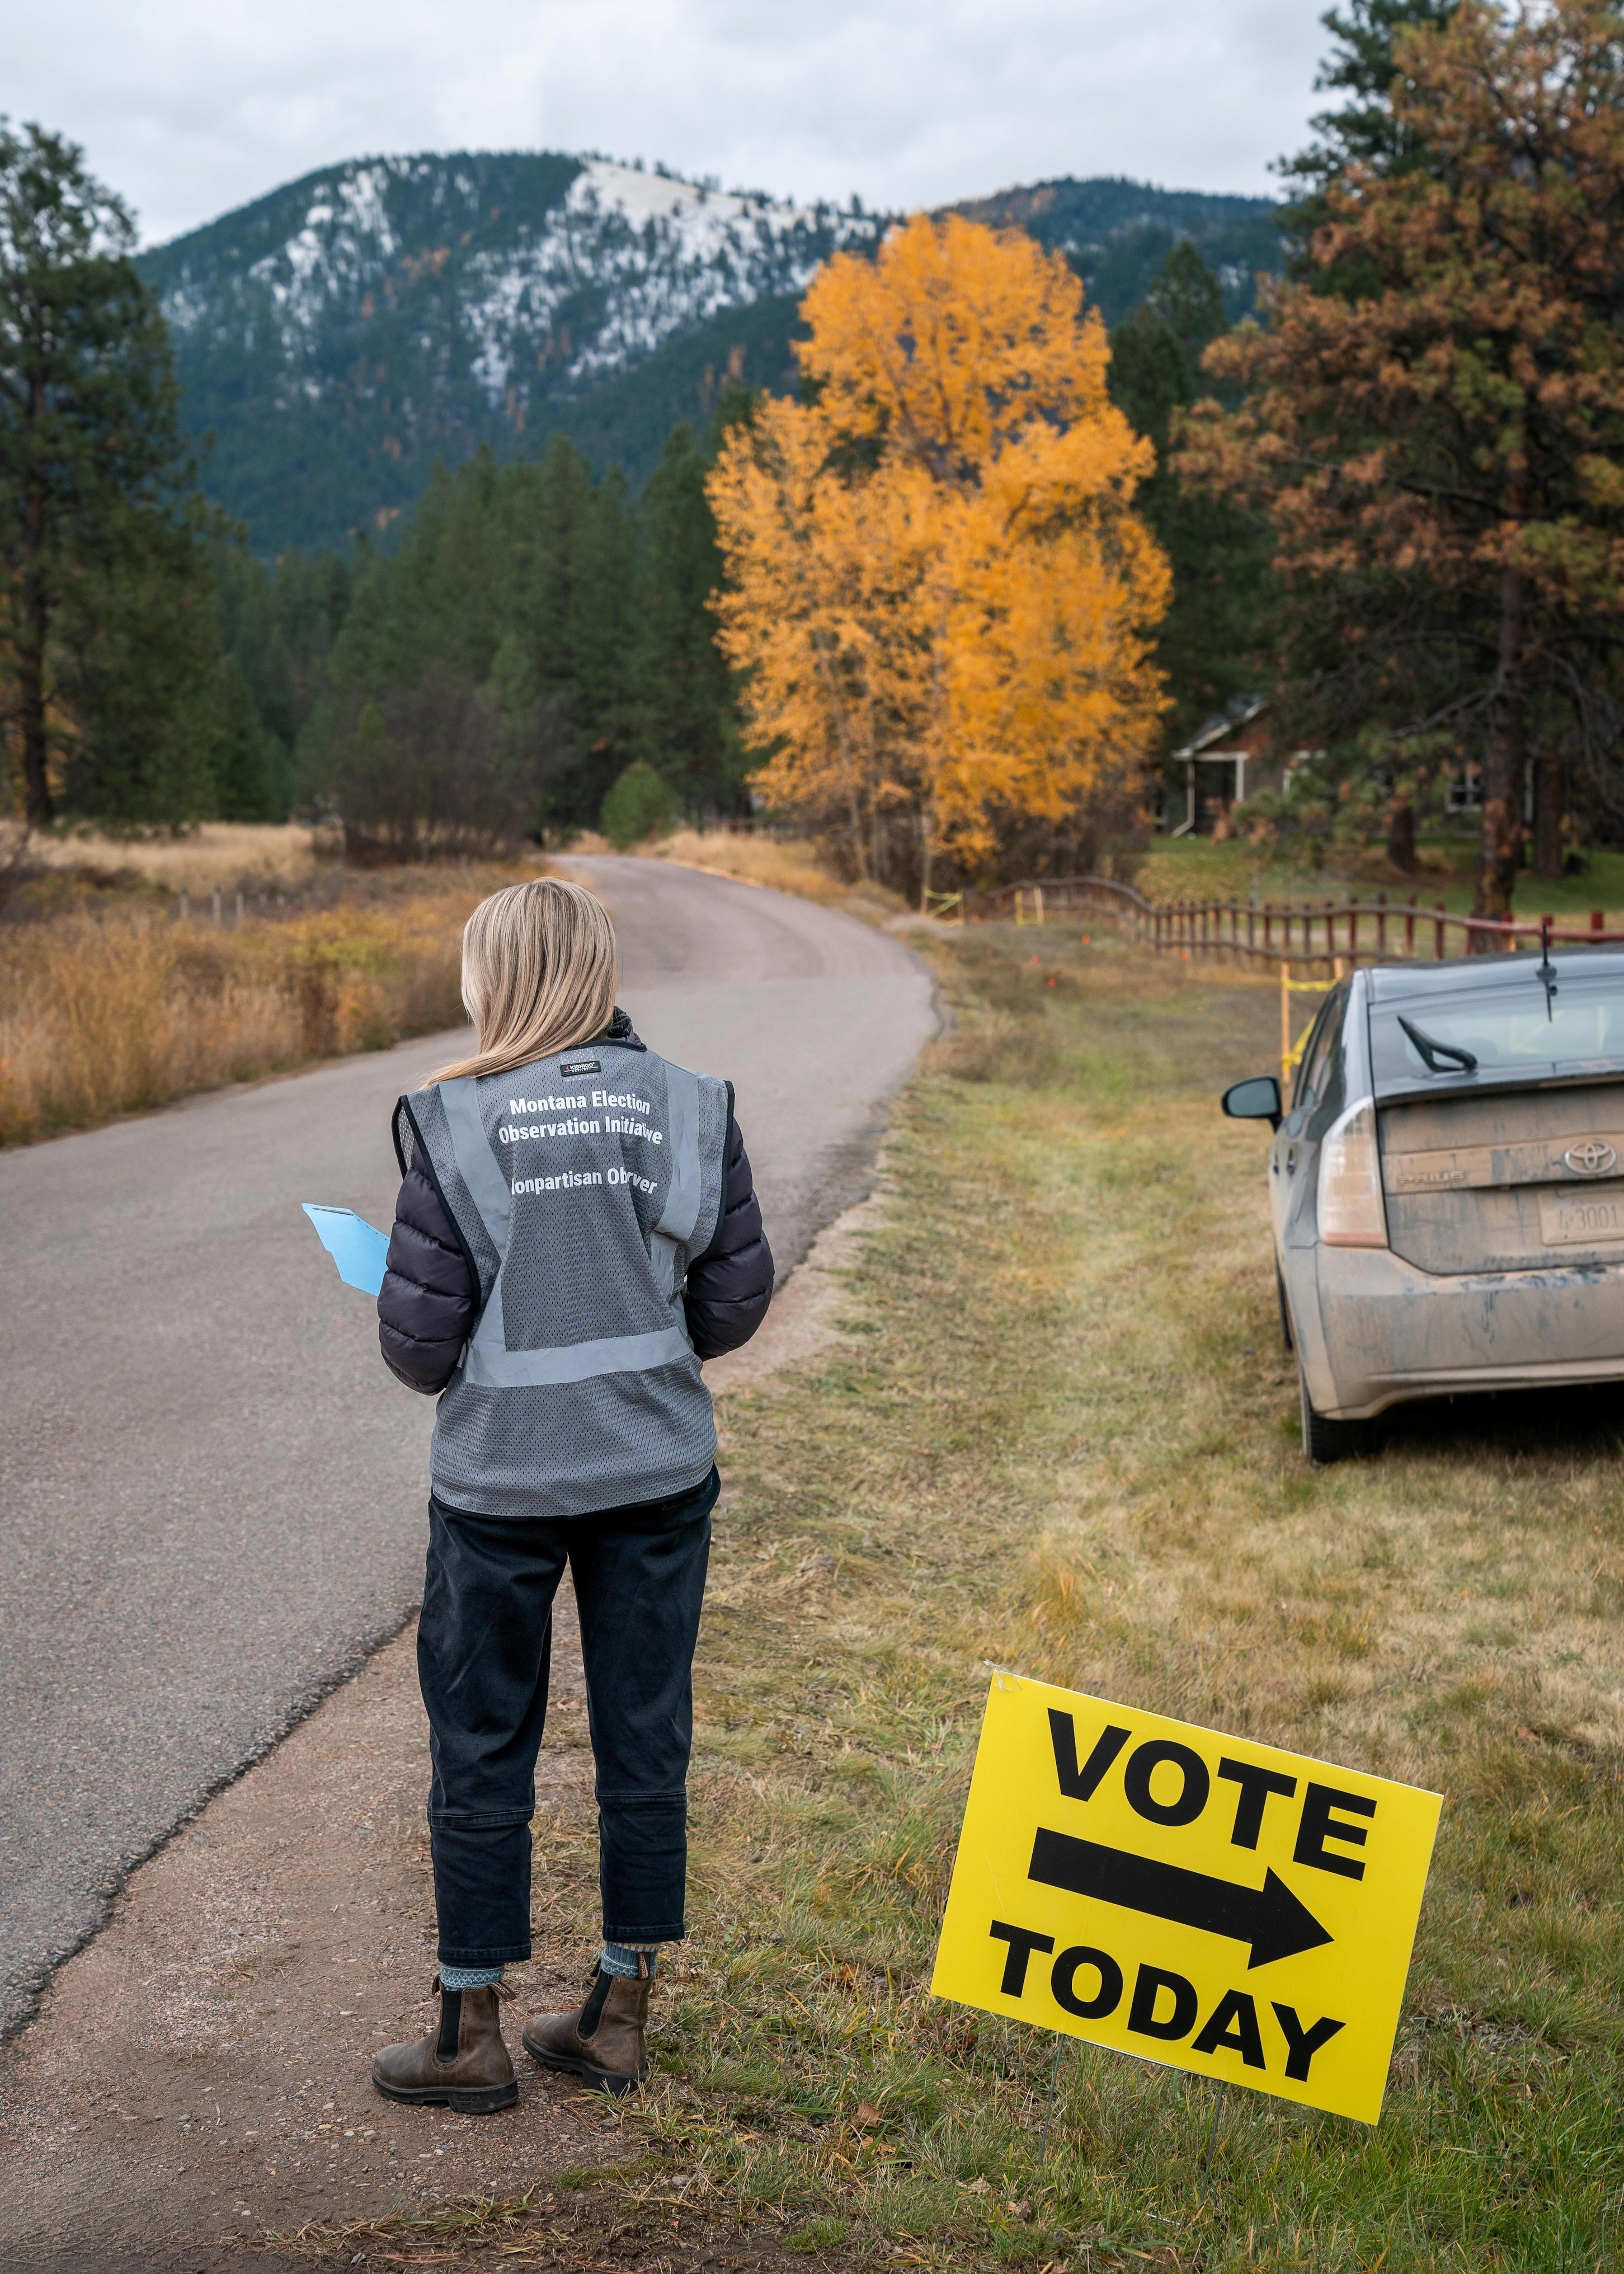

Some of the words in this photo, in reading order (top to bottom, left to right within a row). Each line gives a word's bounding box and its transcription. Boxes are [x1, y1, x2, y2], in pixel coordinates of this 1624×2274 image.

[498, 1117, 600, 1144] Observation
[510, 1095, 587, 1115] Montana
[591, 1090, 650, 1115] Election
[1047, 1708, 1377, 1881] VOTE
[989, 1919, 1347, 2082] TODAY
